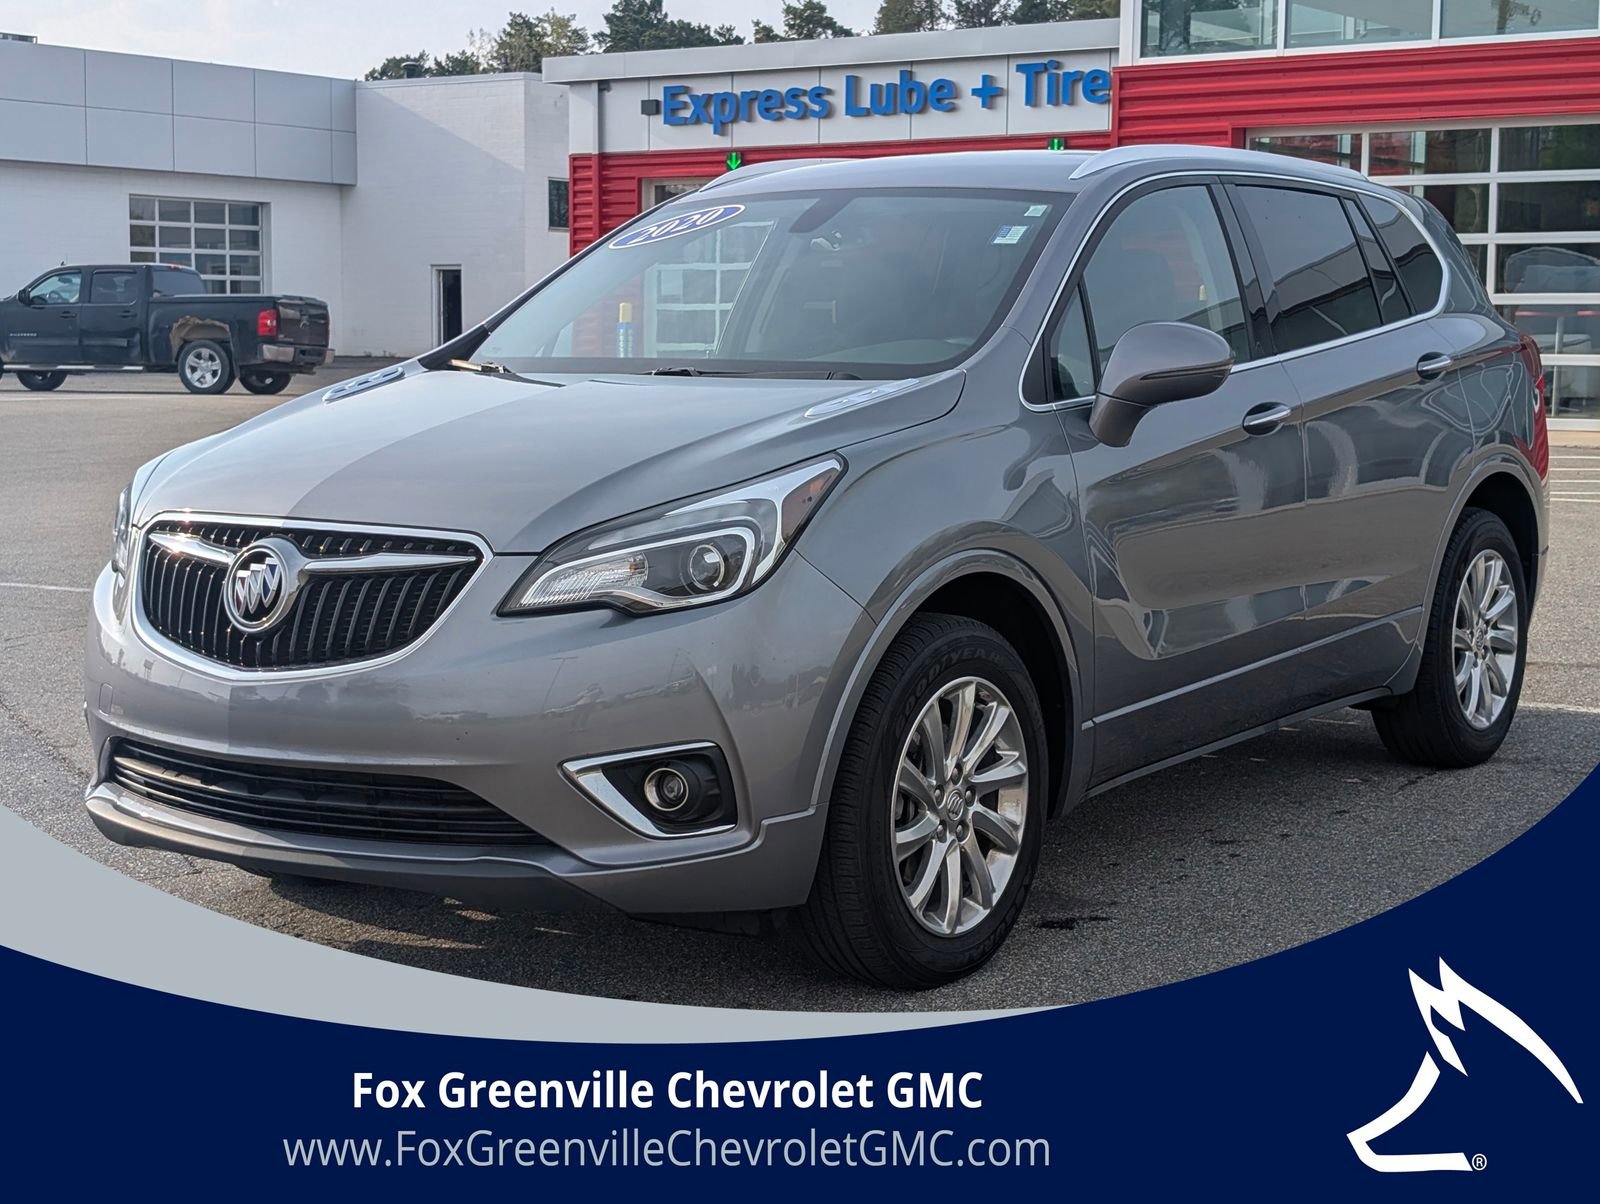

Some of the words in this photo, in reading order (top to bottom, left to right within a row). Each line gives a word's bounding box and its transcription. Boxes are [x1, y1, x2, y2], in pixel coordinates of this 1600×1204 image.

[662, 84, 832, 135] Express
[845, 70, 958, 117] Lube
[971, 74, 1004, 109] +
[1016, 59, 1111, 107] Tire
[626, 208, 725, 245] 2020
